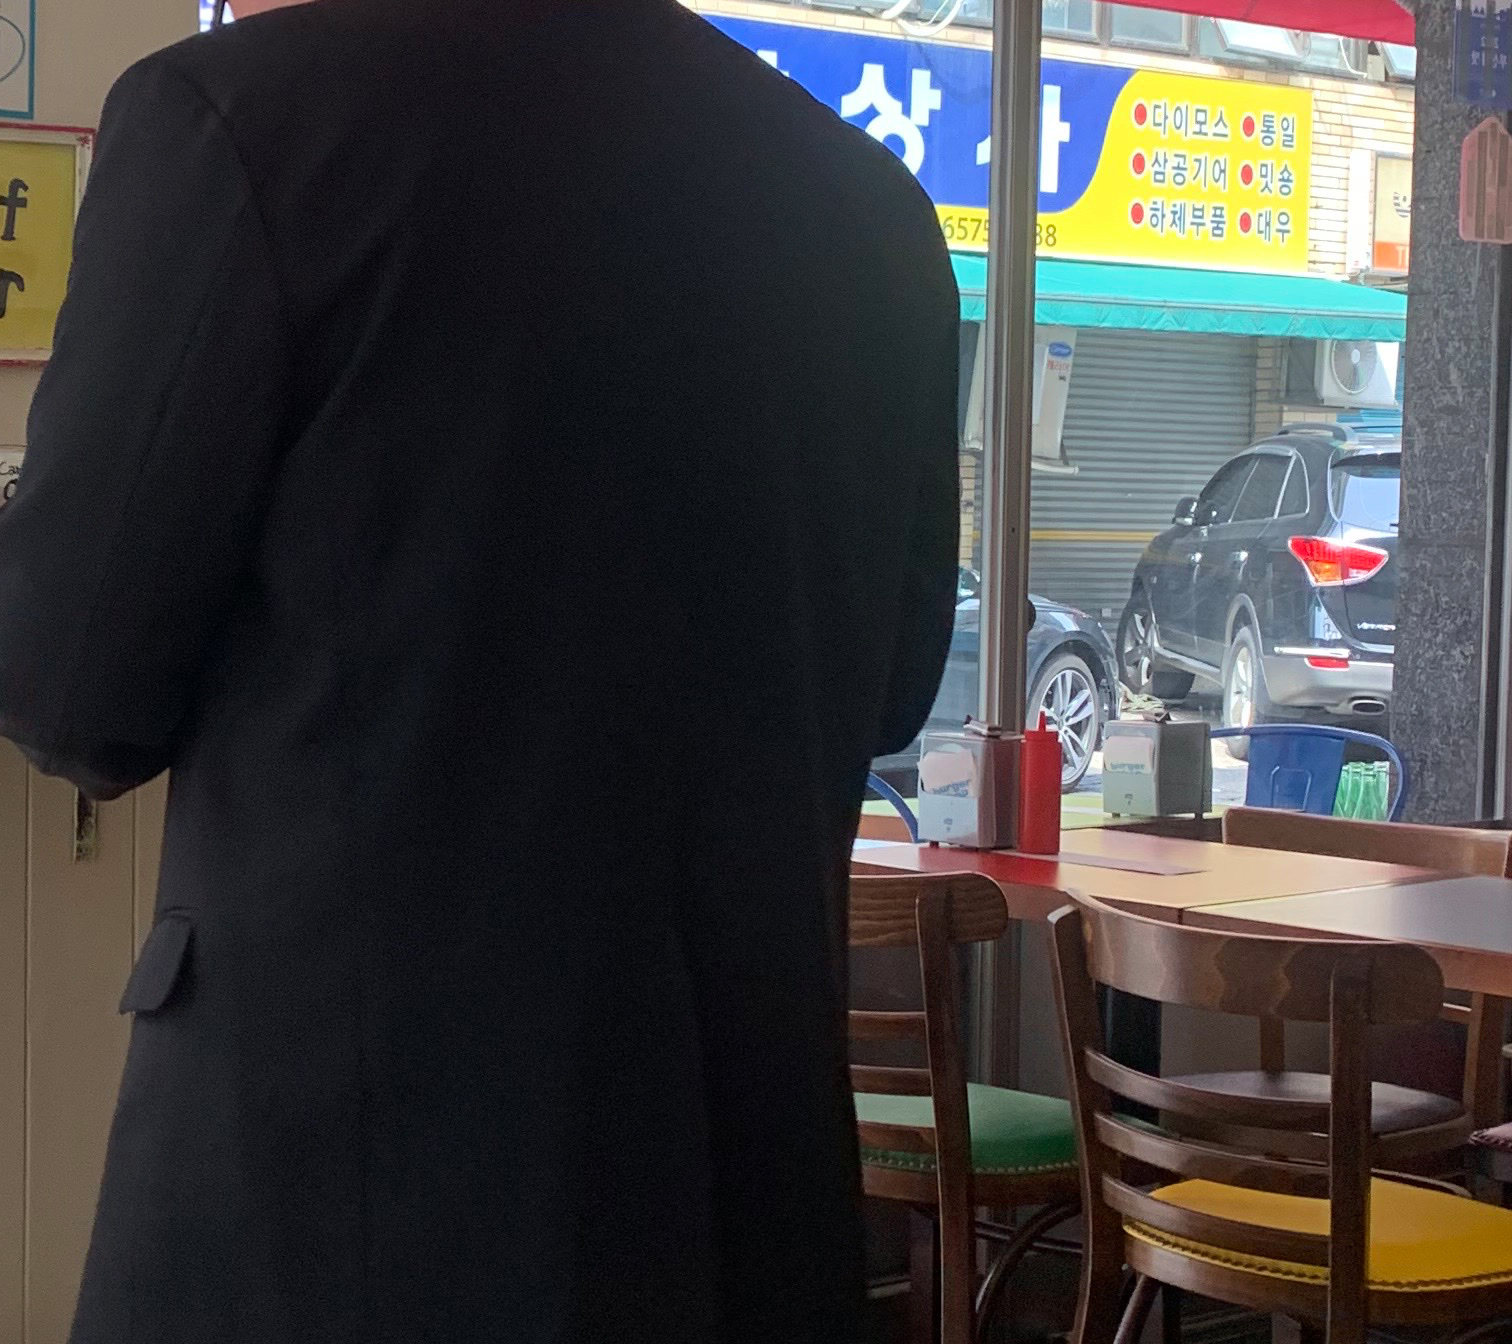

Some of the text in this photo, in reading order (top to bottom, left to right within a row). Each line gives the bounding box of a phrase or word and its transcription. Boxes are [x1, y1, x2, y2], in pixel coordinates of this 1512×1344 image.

[1152, 102, 1295, 149] 다이모스 통일
[1151, 151, 1228, 190] 삼공기어
[1149, 200, 1291, 243] 하체부품 대우
